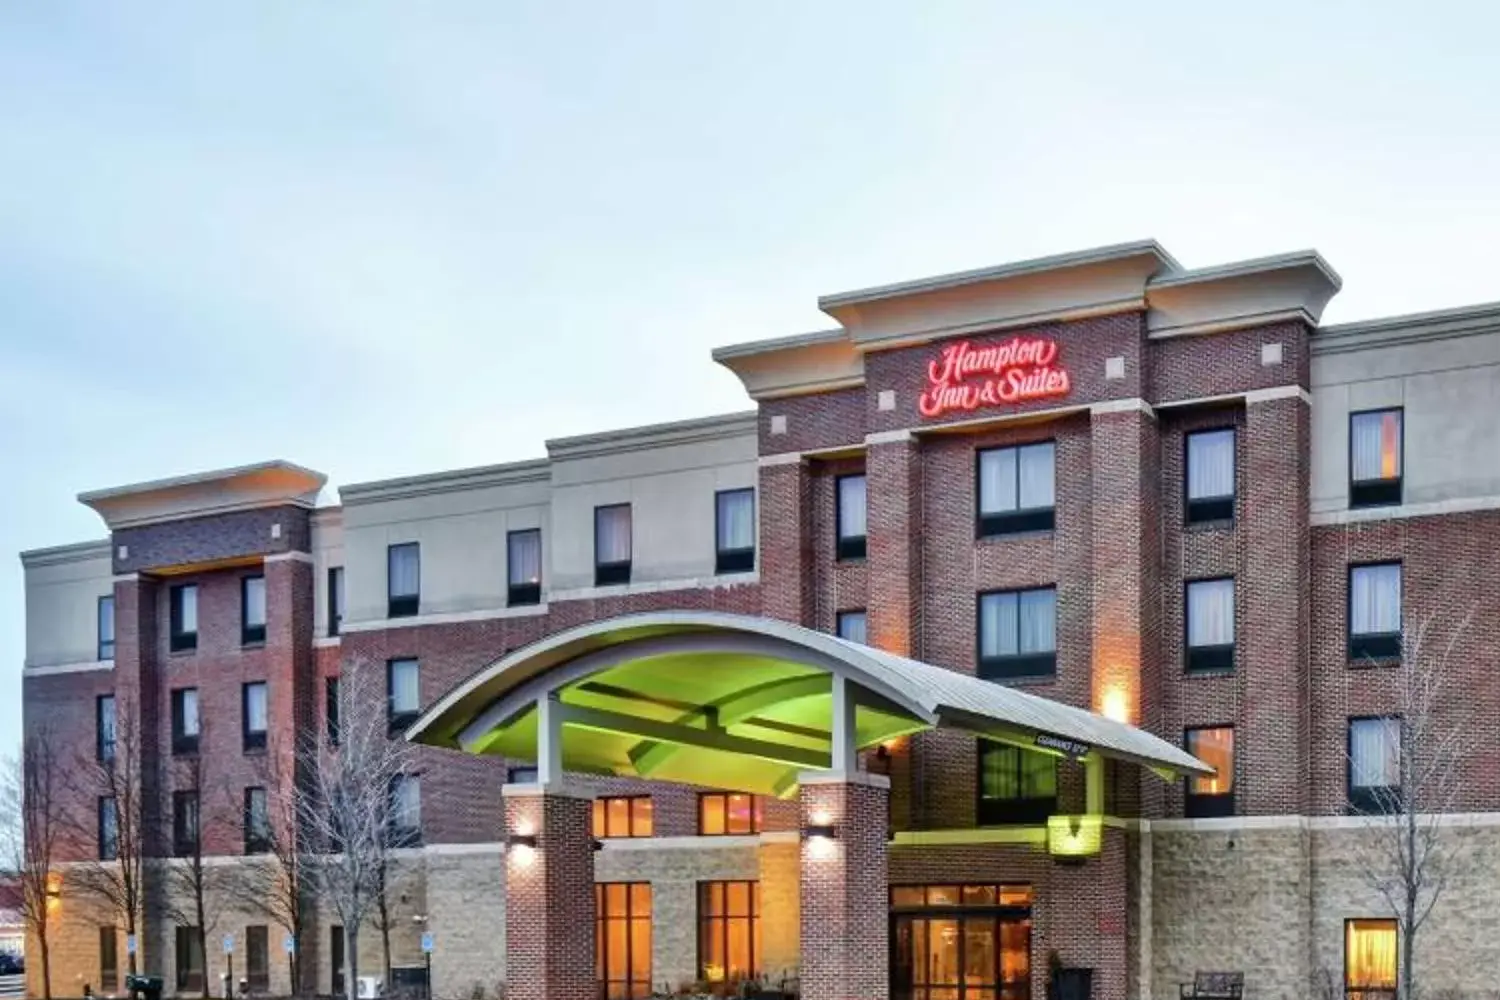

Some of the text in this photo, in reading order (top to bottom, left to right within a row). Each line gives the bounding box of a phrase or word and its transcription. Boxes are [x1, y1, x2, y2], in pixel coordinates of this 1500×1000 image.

[928, 338, 1057, 385] Hampton
[919, 367, 1070, 417] Inn & Suites
